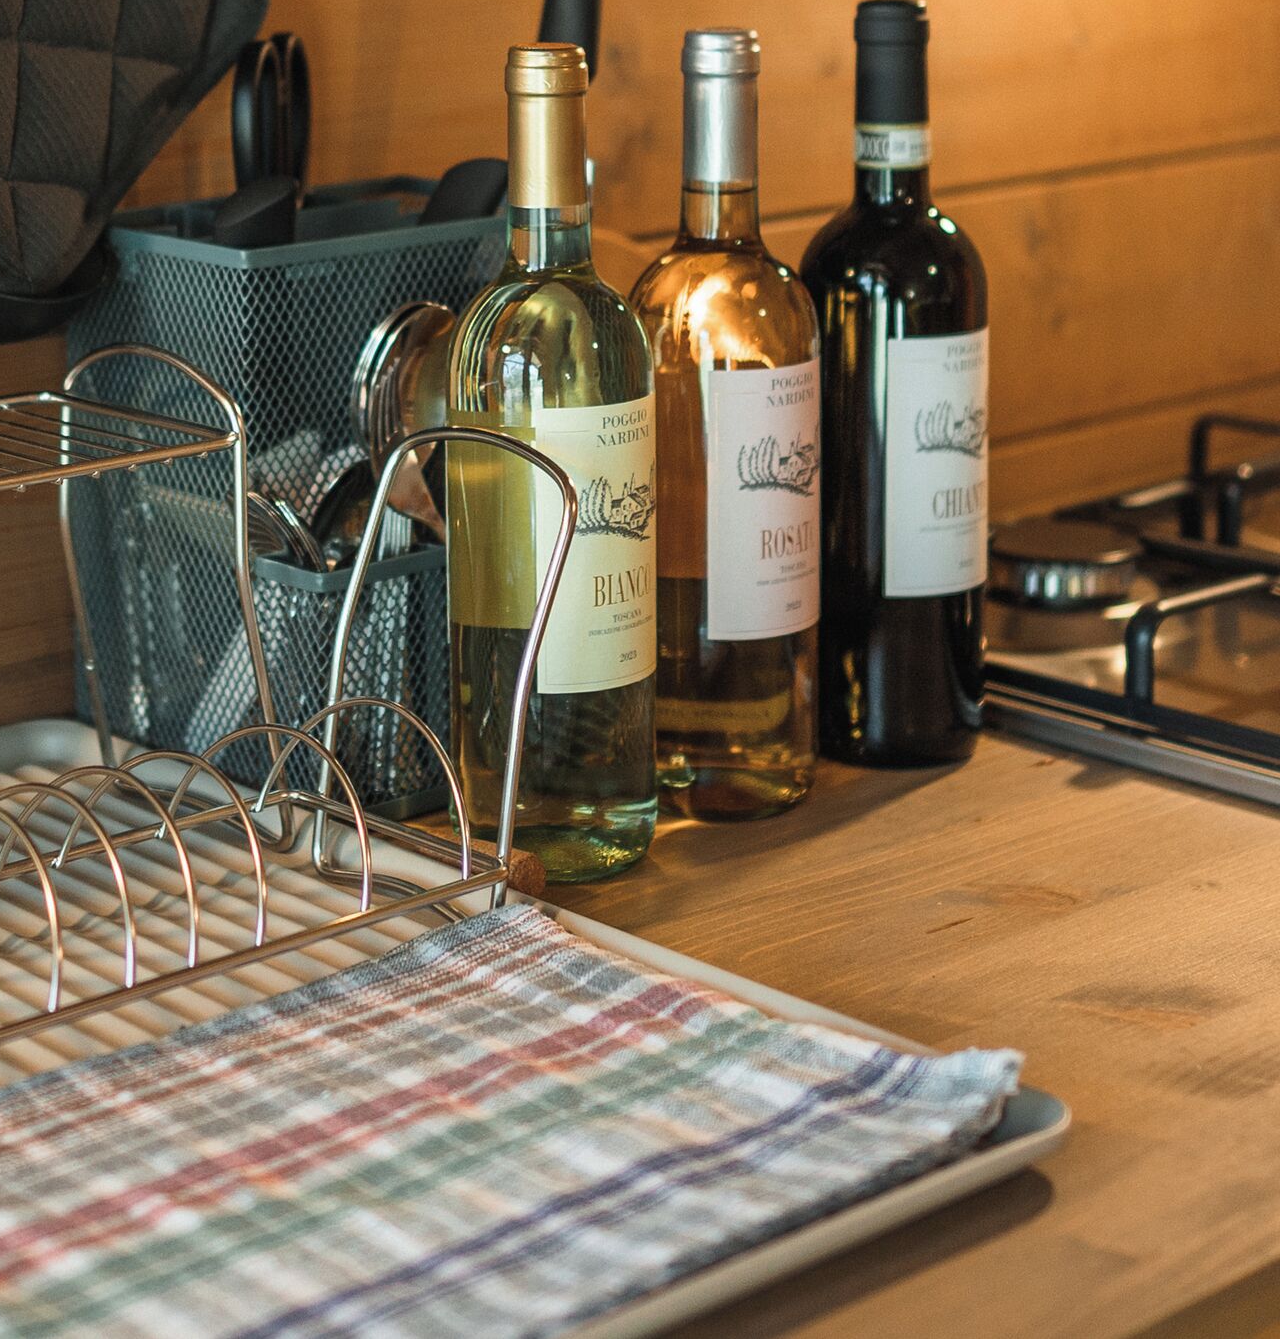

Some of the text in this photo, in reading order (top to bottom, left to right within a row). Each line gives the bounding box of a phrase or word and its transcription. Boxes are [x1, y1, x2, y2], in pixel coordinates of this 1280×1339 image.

[770, 372, 813, 391] POGGIO
[602, 408, 648, 429] POGGIO
[596, 424, 649, 448] NARDINI
[592, 562, 651, 608] BIANCO
